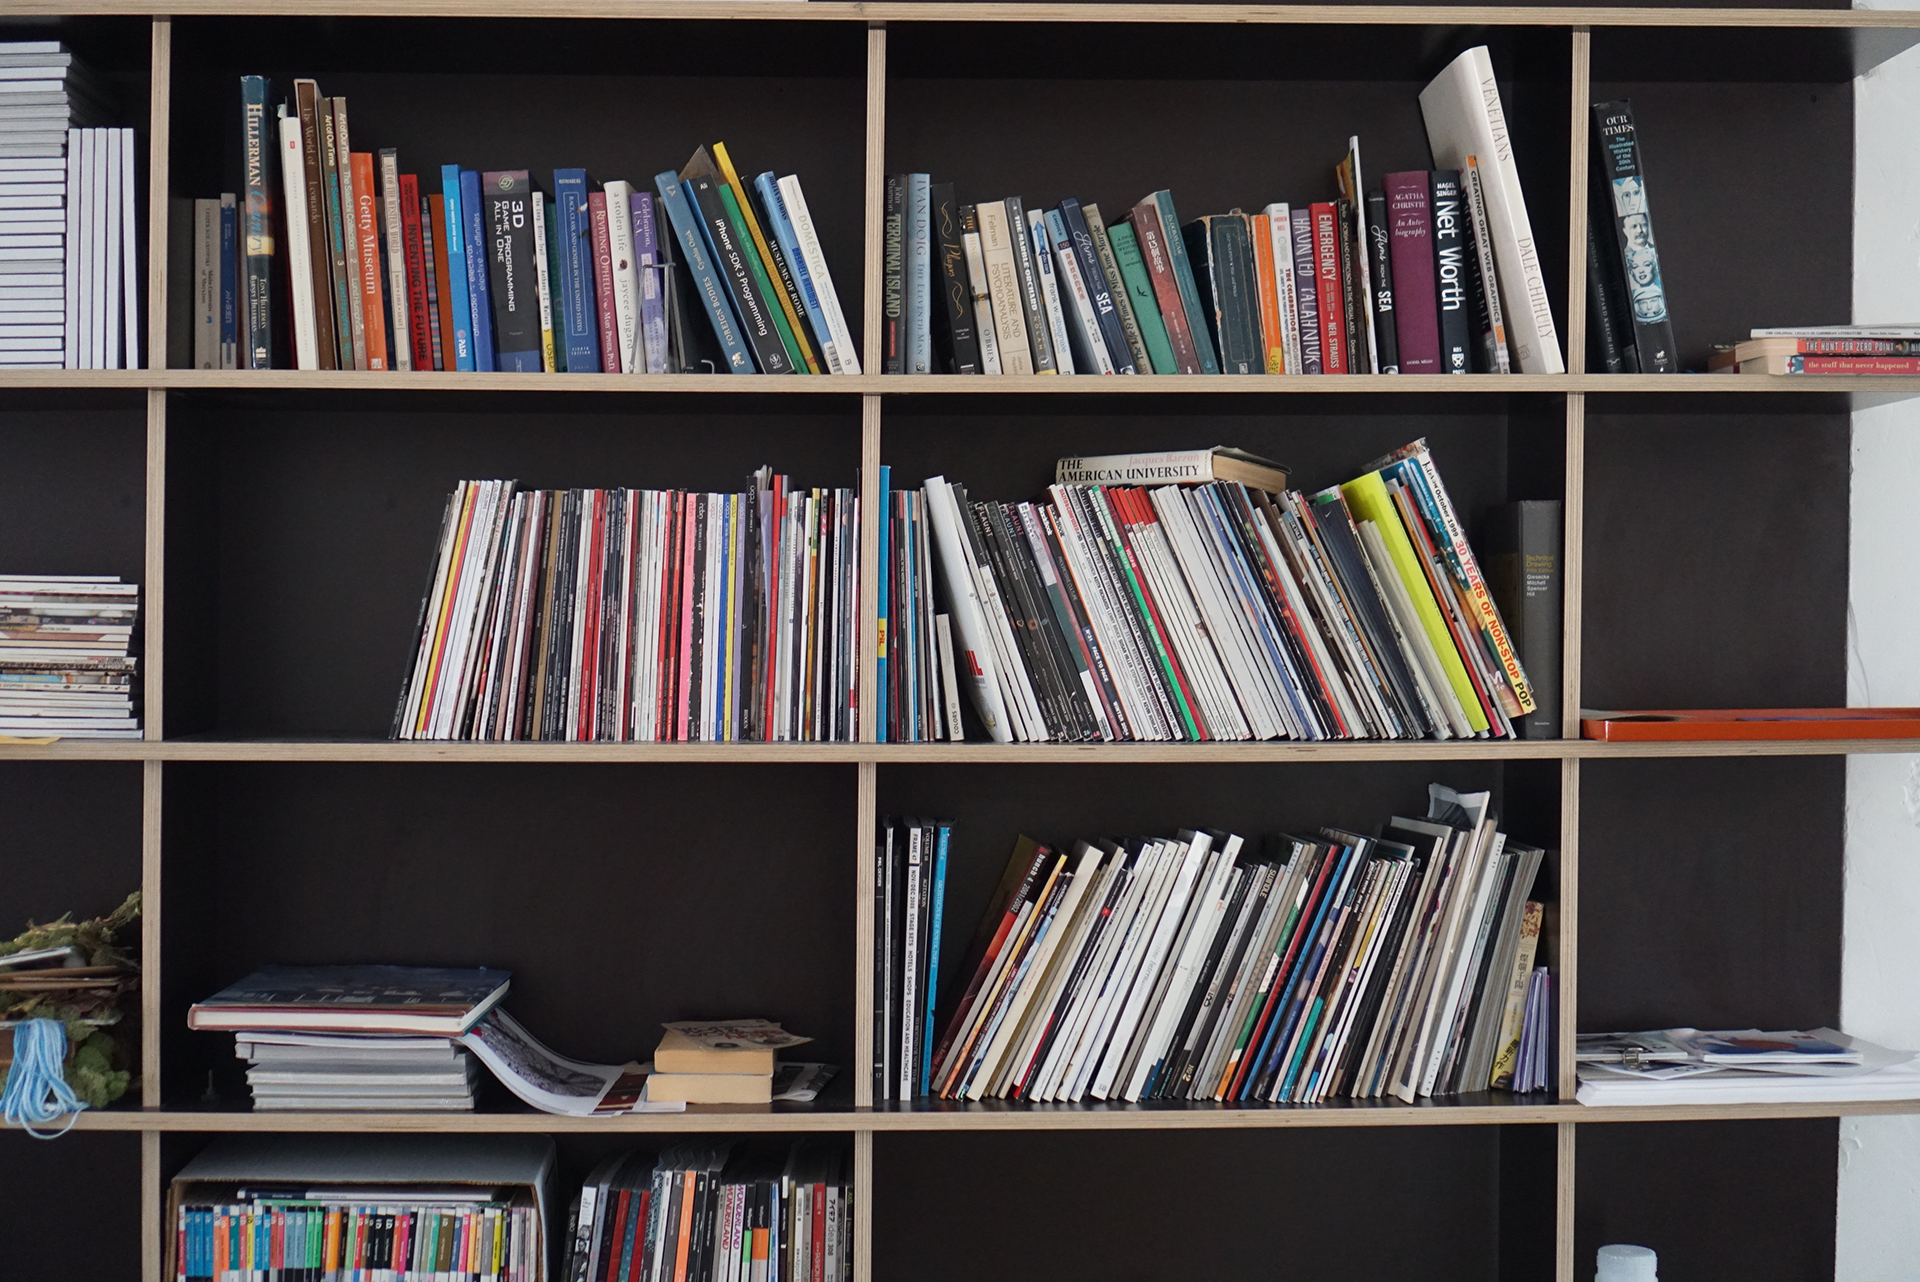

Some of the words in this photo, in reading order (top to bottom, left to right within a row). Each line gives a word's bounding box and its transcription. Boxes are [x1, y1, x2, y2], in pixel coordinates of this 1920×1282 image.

[1479, 76, 1512, 163] VENETIANS
[1602, 124, 1634, 137] TIMES
[1606, 114, 1627, 126] OUR
[246, 103, 264, 186] HILLERMAN
[304, 125, 315, 153] World
[308, 181, 320, 224] Leonardo
[916, 180, 926, 214] IVAN
[1394, 193, 1424, 201] AGATHA
[1436, 190, 1457, 198] SINGER
[1437, 182, 1456, 190] HAGEL
[1470, 170, 1483, 217] CREATING
[247, 190, 267, 253] Country
[356, 194, 374, 231] Getty
[387, 199, 398, 230] WESTERN
[493, 200, 502, 221] ALL
[501, 200, 511, 231] GAME
[511, 200, 524, 228] 3D
[614, 200, 624, 230] stolen
[640, 197, 653, 247] Celebration,
[1392, 201, 1426, 210] CHRISTIE
[1435, 199, 1461, 240] Net
[346, 212, 356, 250] Collection
[595, 210, 609, 253] REVIVING
[916, 219, 926, 255] DOIG
[986, 213, 999, 247] Felman
[1013, 214, 1022, 232] THE
[1091, 222, 1110, 252] Marple
[1394, 228, 1426, 238] biography
[1478, 218, 1488, 249] GREAT
[389, 230, 400, 254] WORLD
[406, 223, 421, 287] INVENTING
[496, 238, 505, 262] ONE
[617, 234, 627, 251] life
[797, 213, 826, 280] DOMÉSTICA
[886, 213, 901, 273] TERMINAL
[1017, 233, 1029, 268] MARBLE
[1292, 217, 1314, 277] HAUNTED
[1318, 214, 1336, 281] EMERGENCY
[1370, 224, 1390, 261] Arms
[1516, 236, 1538, 275] DALE
[362, 233, 379, 294] Museum
[466, 244, 475, 282] electivas
[475, 257, 485, 291] elective
[503, 234, 516, 312] PROGRAMMING
[599, 254, 613, 296] OPHELIA
[768, 239, 790, 281] MUSEUMS
[1071, 227, 1099, 268] Arms
[1094, 291, 1114, 315] SEA
[1483, 251, 1492, 272] WEB
[571, 245, 579, 268] GENDER
[575, 311, 583, 331] STATES
[618, 277, 630, 311] jaycee
[702, 275, 720, 308] BODIES
[714, 217, 734, 251] iPhone
[728, 251, 742, 271] SDK
[737, 276, 769, 338] Programming
[785, 279, 796, 293] OF
[791, 246, 808, 278] DASHIELL
[801, 276, 819, 310] HAMMETT
[1024, 268, 1038, 311] ORCHARD
[1438, 246, 1466, 311] Worth
[412, 289, 424, 312] THE
[790, 292, 806, 318] ROME
[885, 274, 901, 317] ISLAND
[916, 284, 925, 330] ELEVENTH
[990, 262, 1012, 341] PSYCHOANALYSIS
[1000, 261, 1018, 316] LITERATURE
[1010, 318, 1021, 338] AND
[1116, 297, 1131, 322] Times
[1286, 283, 1296, 332] CELEBRATION
[1377, 290, 1392, 312] SEA
[1486, 274, 1500, 323] GRAPHICS
[1525, 275, 1554, 341] CHIHULY
[621, 314, 635, 351] dugard
[714, 307, 736, 347] FOREIGN
[1032, 315, 1043, 350] NOLAN
[1048, 282, 1058, 303] frank
[1053, 315, 1067, 354] abagnale
[1298, 286, 1321, 365] PALAHNIUK
[1327, 321, 1337, 336] NEIL
[414, 314, 428, 361] FUTURE
[458, 339, 466, 357] PADI
[982, 328, 995, 363] O'BRIEN
[1328, 337, 1339, 368] STRAUSS
[1806, 342, 1818, 351] THE
[1820, 342, 1839, 351] HUNT
[1841, 342, 1853, 351] FOR
[1856, 342, 1872, 351] ZERO
[1874, 342, 1894, 351] POINT
[1808, 361, 1819, 369] the
[1820, 361, 1838, 369] stuff
[1876, 362, 1910, 371] happened
[1058, 467, 1123, 483] AMERICAN
[1126, 464, 1200, 480] UNIVERSITY
[1059, 458, 1083, 471] THE
[1128, 455, 1164, 468] Jacques
[482, 489, 491, 510] COLORS
[490, 482, 500, 504] COLORS
[498, 489, 509, 514] COLORS
[977, 505, 993, 538] FLAUNT
[1008, 504, 1024, 537] FLAUNT
[1056, 554, 1071, 584] PROGRESSIVE
[1525, 554, 1554, 562] Technical
[1526, 561, 1552, 569] Drawing
[1098, 588, 1110, 610] RICHARDS
[1434, 488, 1451, 518] October
[1446, 518, 1459, 537] 1999
[1454, 539, 1468, 557] 30
[1461, 557, 1486, 600] YEARS
[1479, 600, 1494, 619] OF
[1487, 618, 1520, 681] NON-STOP
[1513, 681, 1532, 708] POP
[1526, 585, 1548, 593] Spencer
[1091, 645, 1101, 661] FACE
[1100, 668, 1109, 683] FACE
[1111, 700, 1124, 722] WINTER
[1136, 633, 1149, 657] WESTERN
[1162, 699, 1175, 721] RICHARD
[951, 710, 959, 734] COLORS
[1028, 852, 1046, 877] hunch
[920, 878, 928, 907] AGITATION
[1009, 881, 1031, 914] 2001/2002
[722, 1184, 733, 1250] WONDERLAND
[732, 1184, 744, 1250] WONDERLAND
[828, 1198, 836, 1222] アイデア
[827, 1224, 836, 1242] idea
[813, 1251, 821, 1277] FASHION
